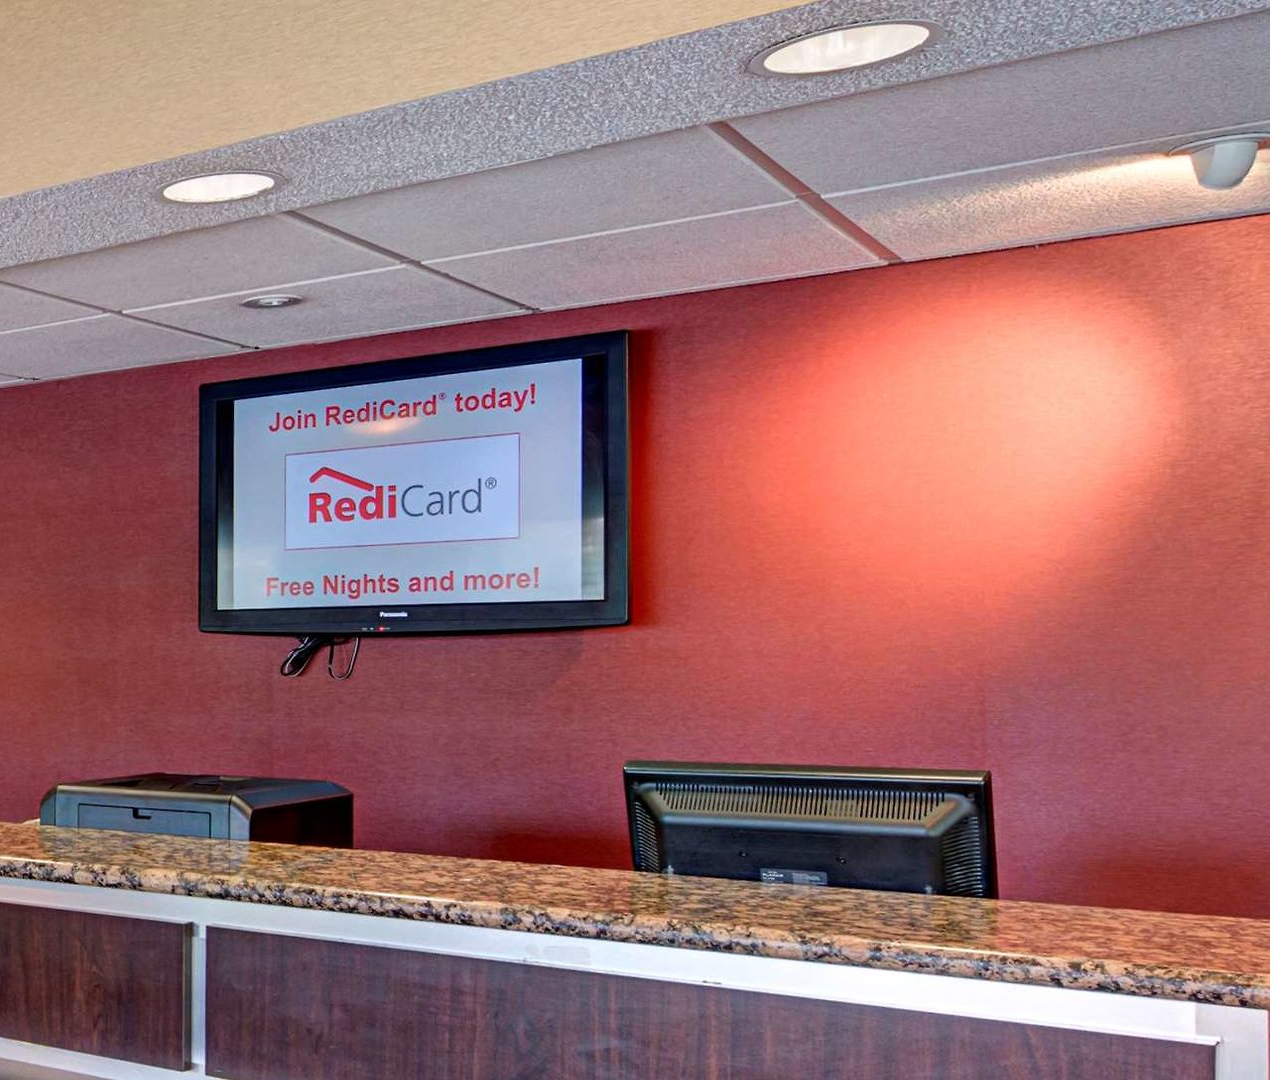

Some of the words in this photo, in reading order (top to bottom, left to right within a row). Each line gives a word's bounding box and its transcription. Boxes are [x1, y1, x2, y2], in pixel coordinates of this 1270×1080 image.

[269, 410, 317, 432] Join
[455, 383, 536, 412] today!
[266, 577, 315, 597] Free
[323, 575, 400, 599] Nights
[408, 570, 454, 592] and
[463, 567, 540, 591] more!
